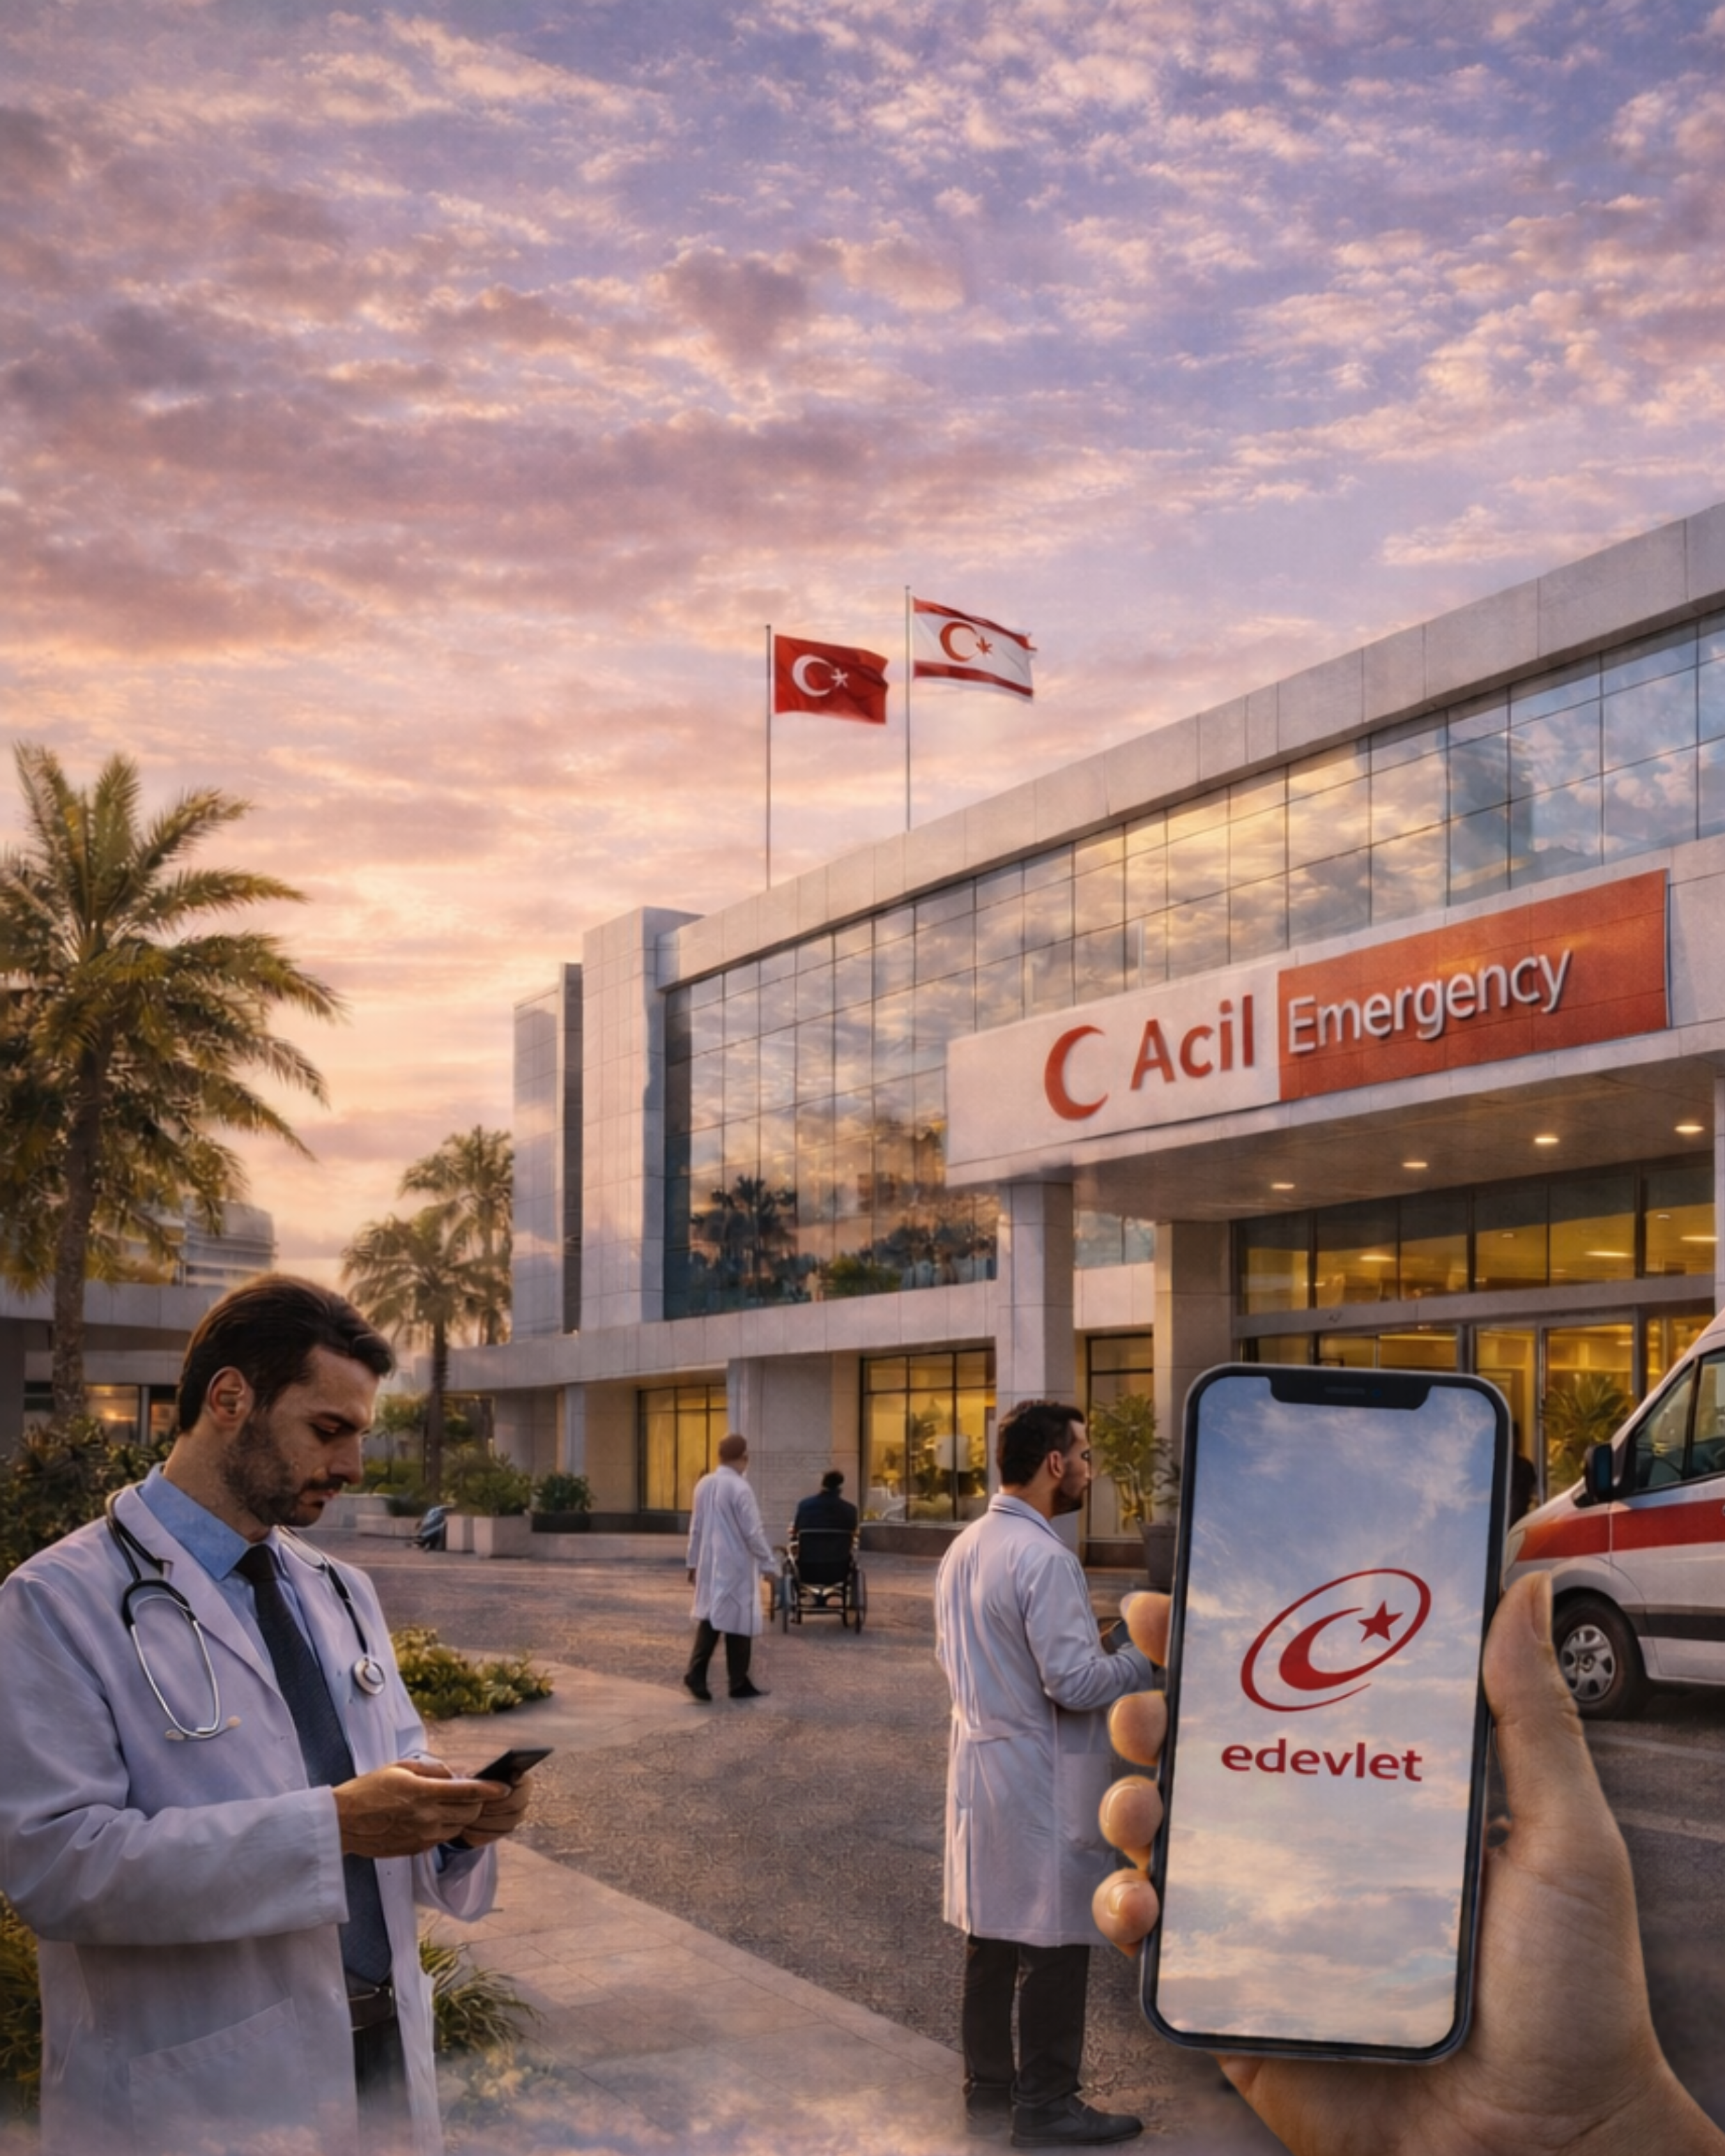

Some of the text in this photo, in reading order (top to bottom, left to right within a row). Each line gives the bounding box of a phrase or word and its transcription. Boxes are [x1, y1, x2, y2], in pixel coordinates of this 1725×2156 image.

[1130, 948, 1571, 1090] Acil Emergency
[1221, 1738, 1423, 1782] edevlet
